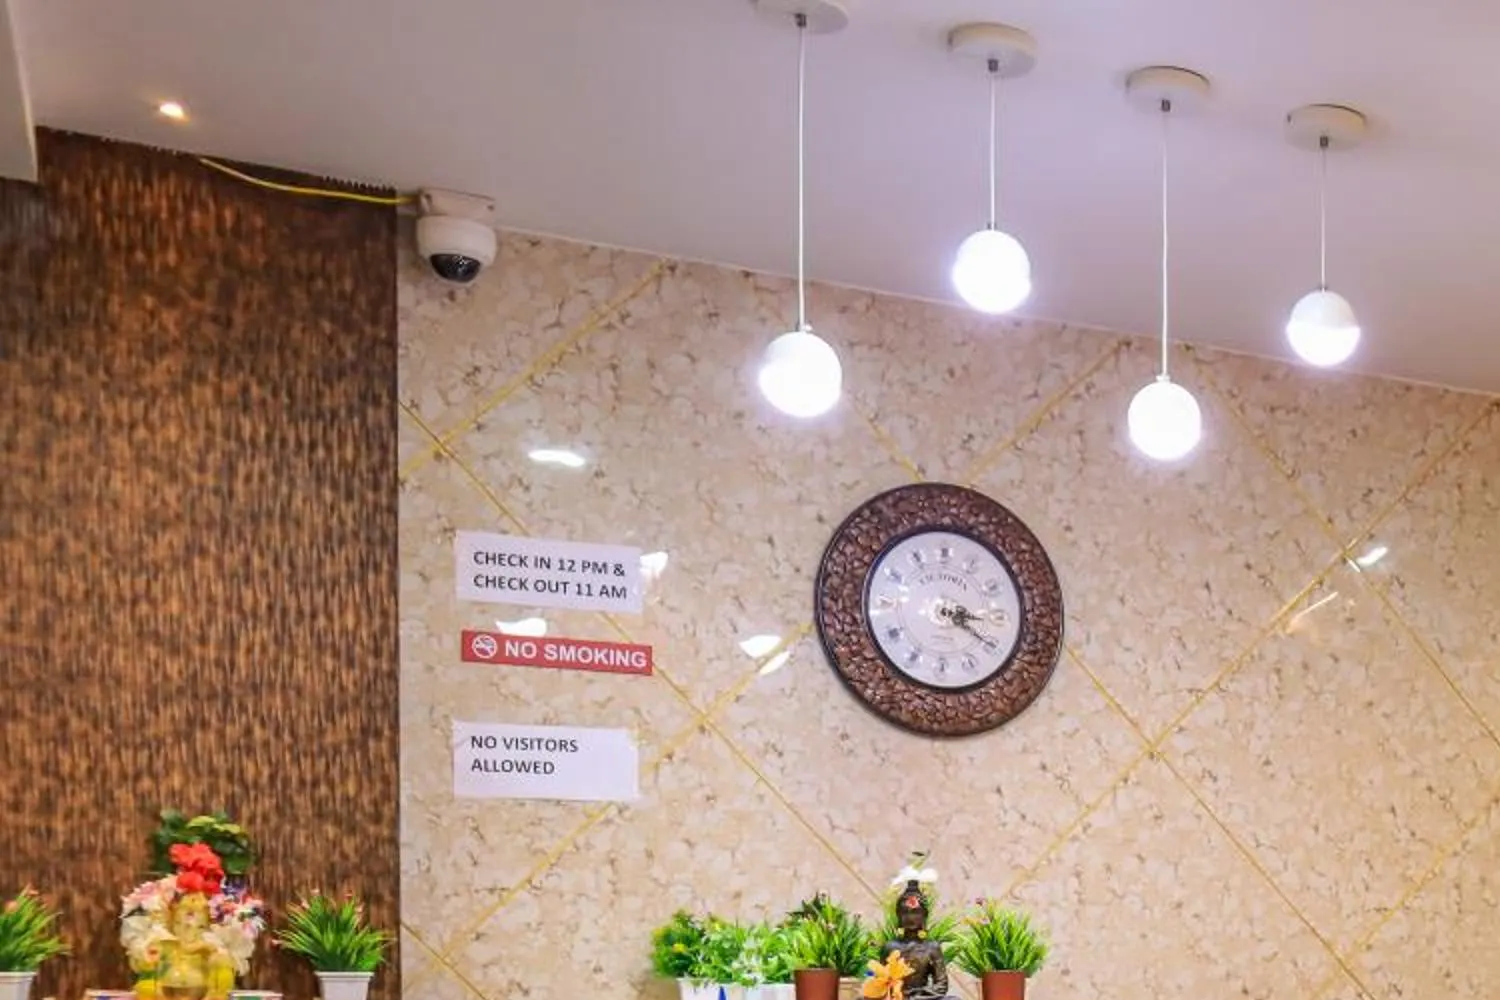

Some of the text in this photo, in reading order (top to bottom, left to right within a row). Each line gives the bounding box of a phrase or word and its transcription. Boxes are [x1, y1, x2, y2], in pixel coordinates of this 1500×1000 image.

[473, 551, 626, 577] CHECK IN 12 PM &
[473, 574, 627, 599] CHECK OUT 11 AM
[505, 640, 648, 668] NO SMOKING
[471, 735, 579, 753] NO VISITORS
[470, 758, 555, 775] ALLOWED
